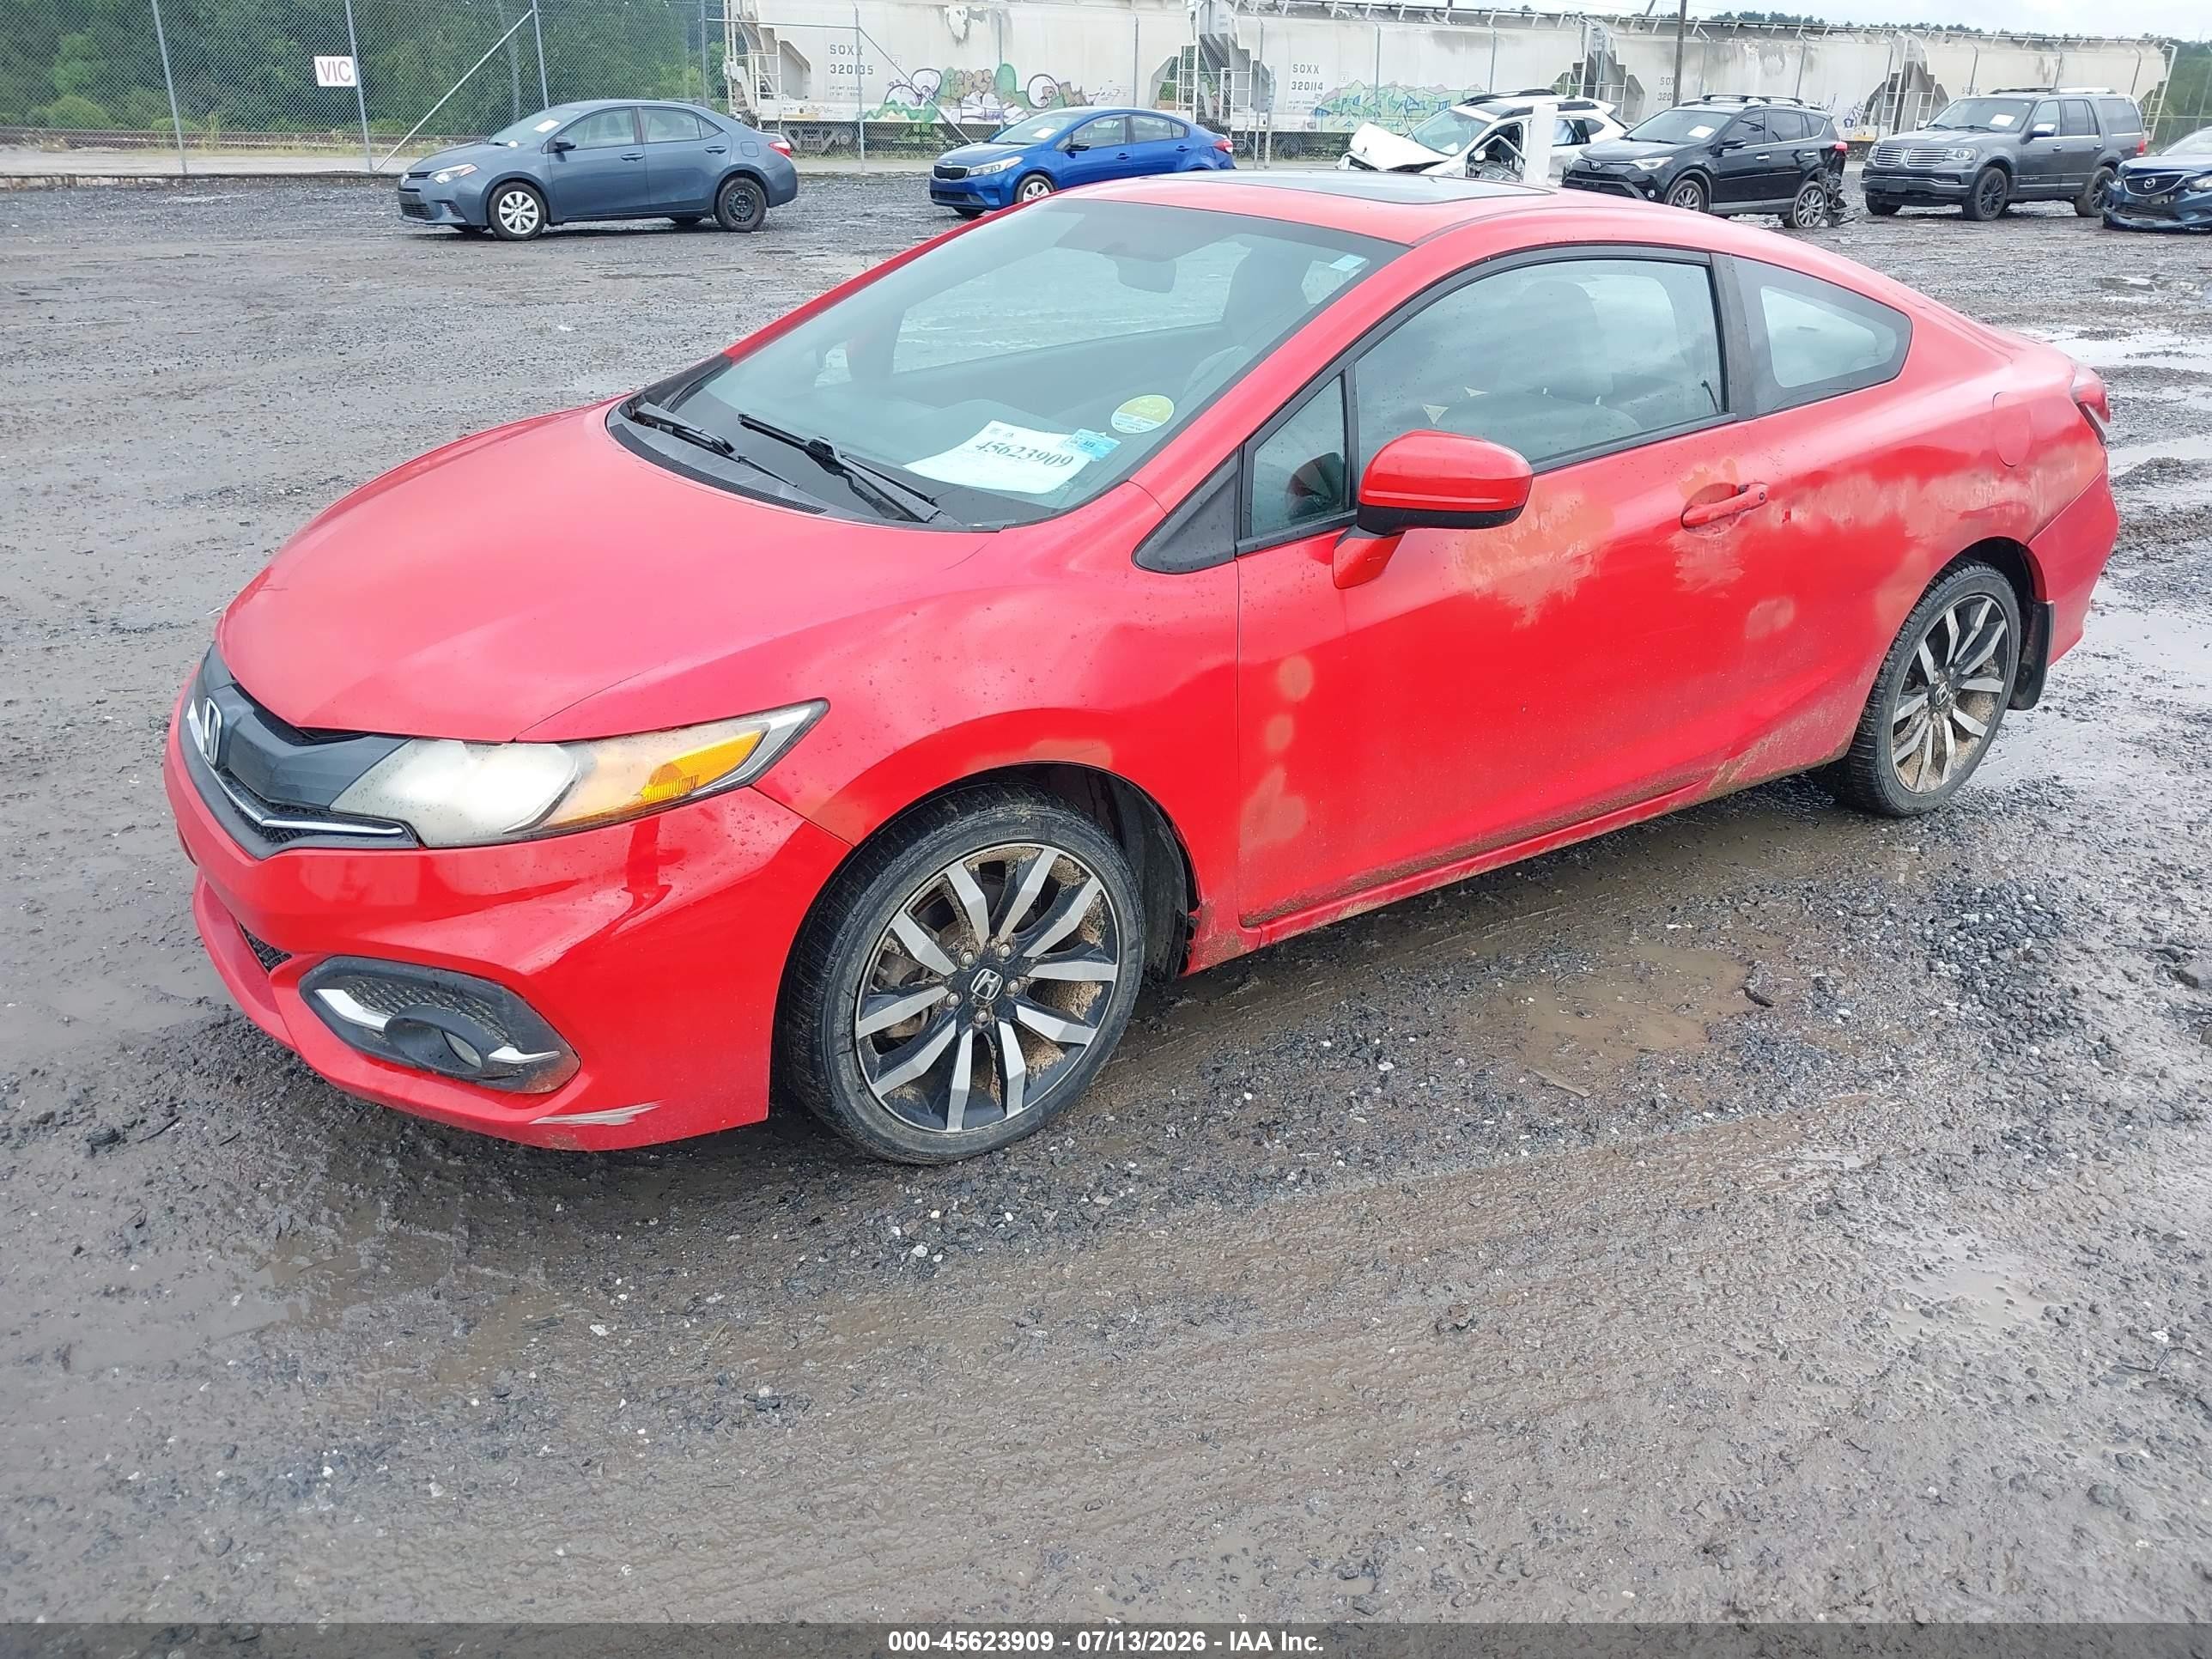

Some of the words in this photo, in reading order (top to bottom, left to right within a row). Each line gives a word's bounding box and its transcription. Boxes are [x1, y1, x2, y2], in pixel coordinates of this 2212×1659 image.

[830, 45, 863, 56] SOXX
[319, 60, 351, 82] VIC
[830, 64, 873, 76] 320135
[1292, 64, 1319, 75] SOXX
[1291, 81, 1323, 91] 320114
[975, 441, 1074, 468] 45623909
